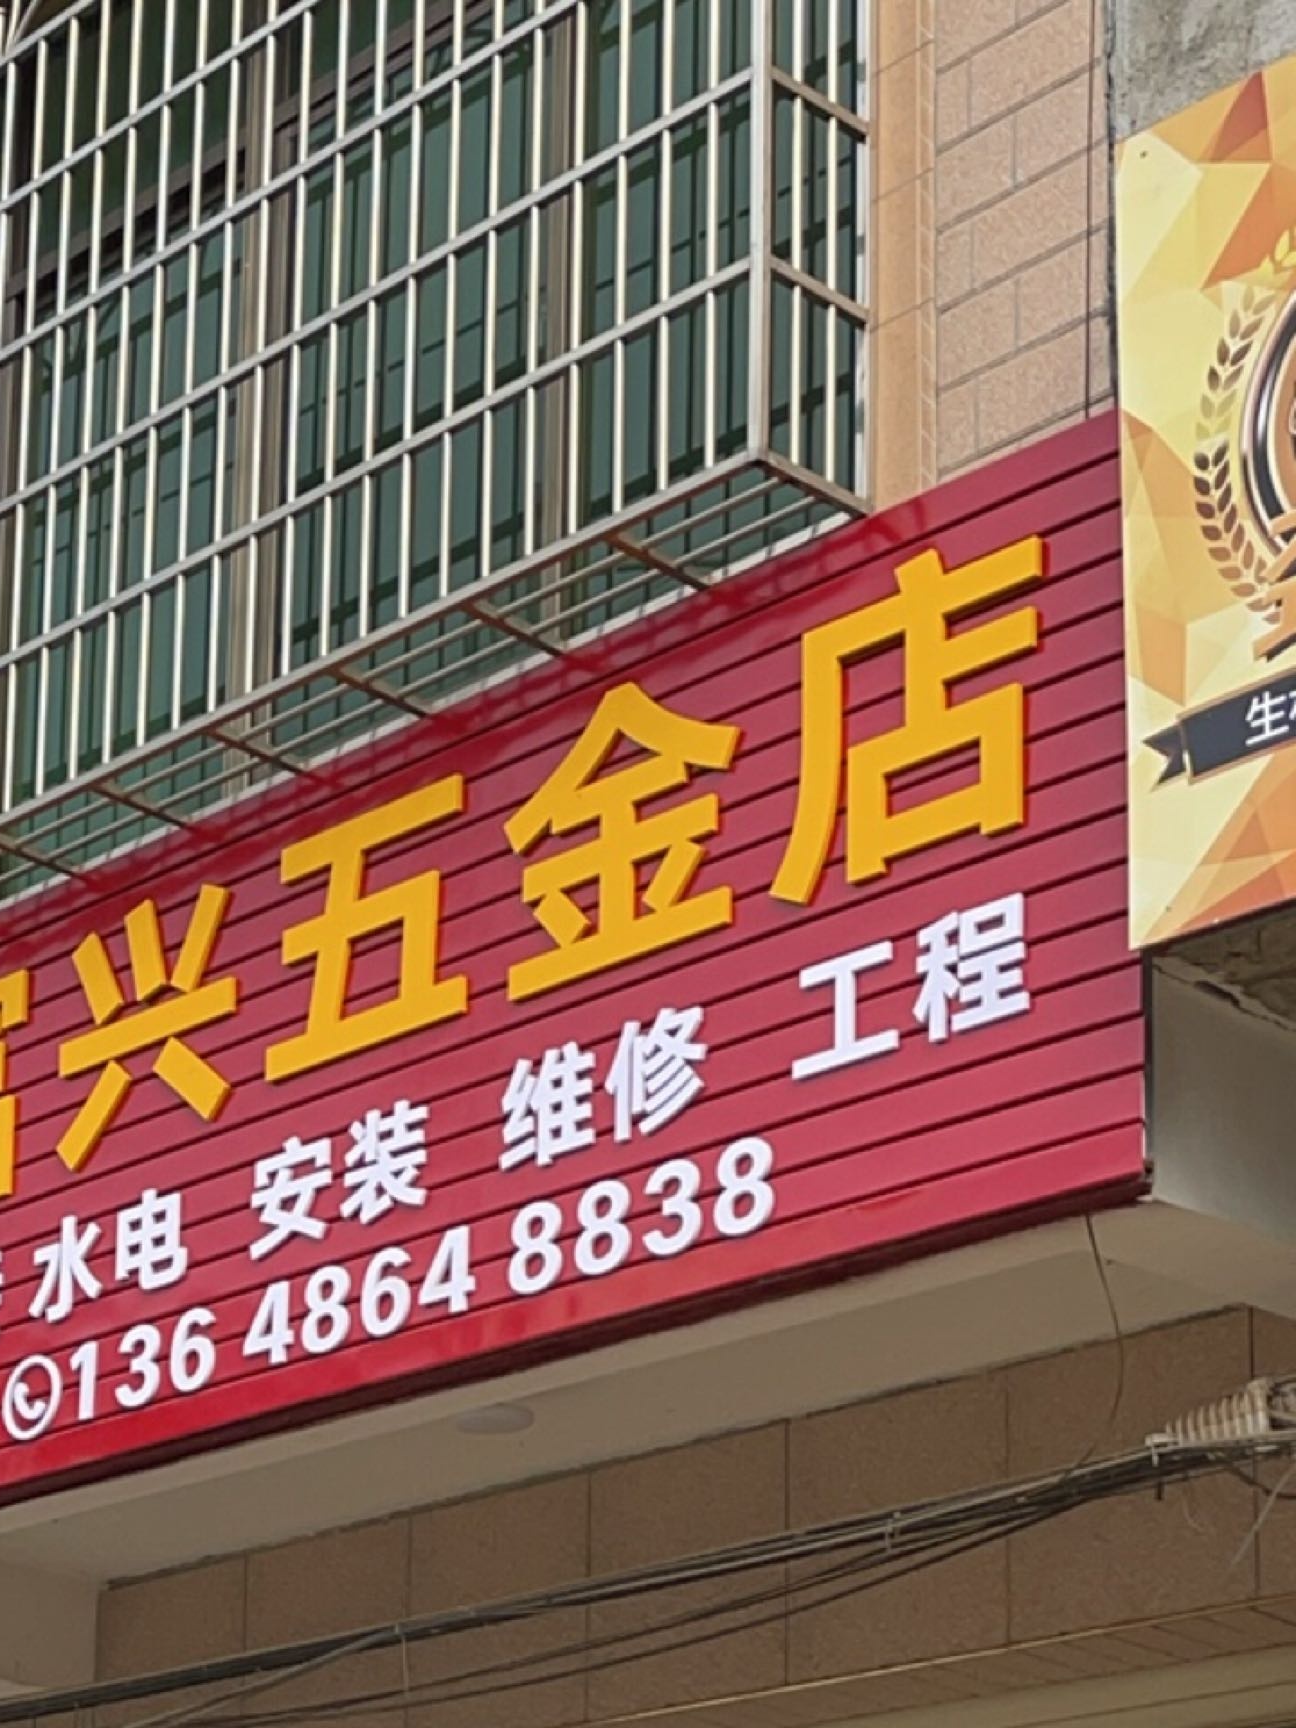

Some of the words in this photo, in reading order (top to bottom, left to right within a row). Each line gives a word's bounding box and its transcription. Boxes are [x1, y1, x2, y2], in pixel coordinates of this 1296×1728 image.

[1245, 690, 1296, 746] 生
[29, 1188, 189, 1323] 水电
[249, 1099, 430, 1260] 安装
[499, 1004, 709, 1173] 维修
[791, 891, 1032, 1081] 工程
[70, 1306, 217, 1421] 136
[242, 1225, 476, 1366] 4864
[507, 1136, 776, 1297] 8838
